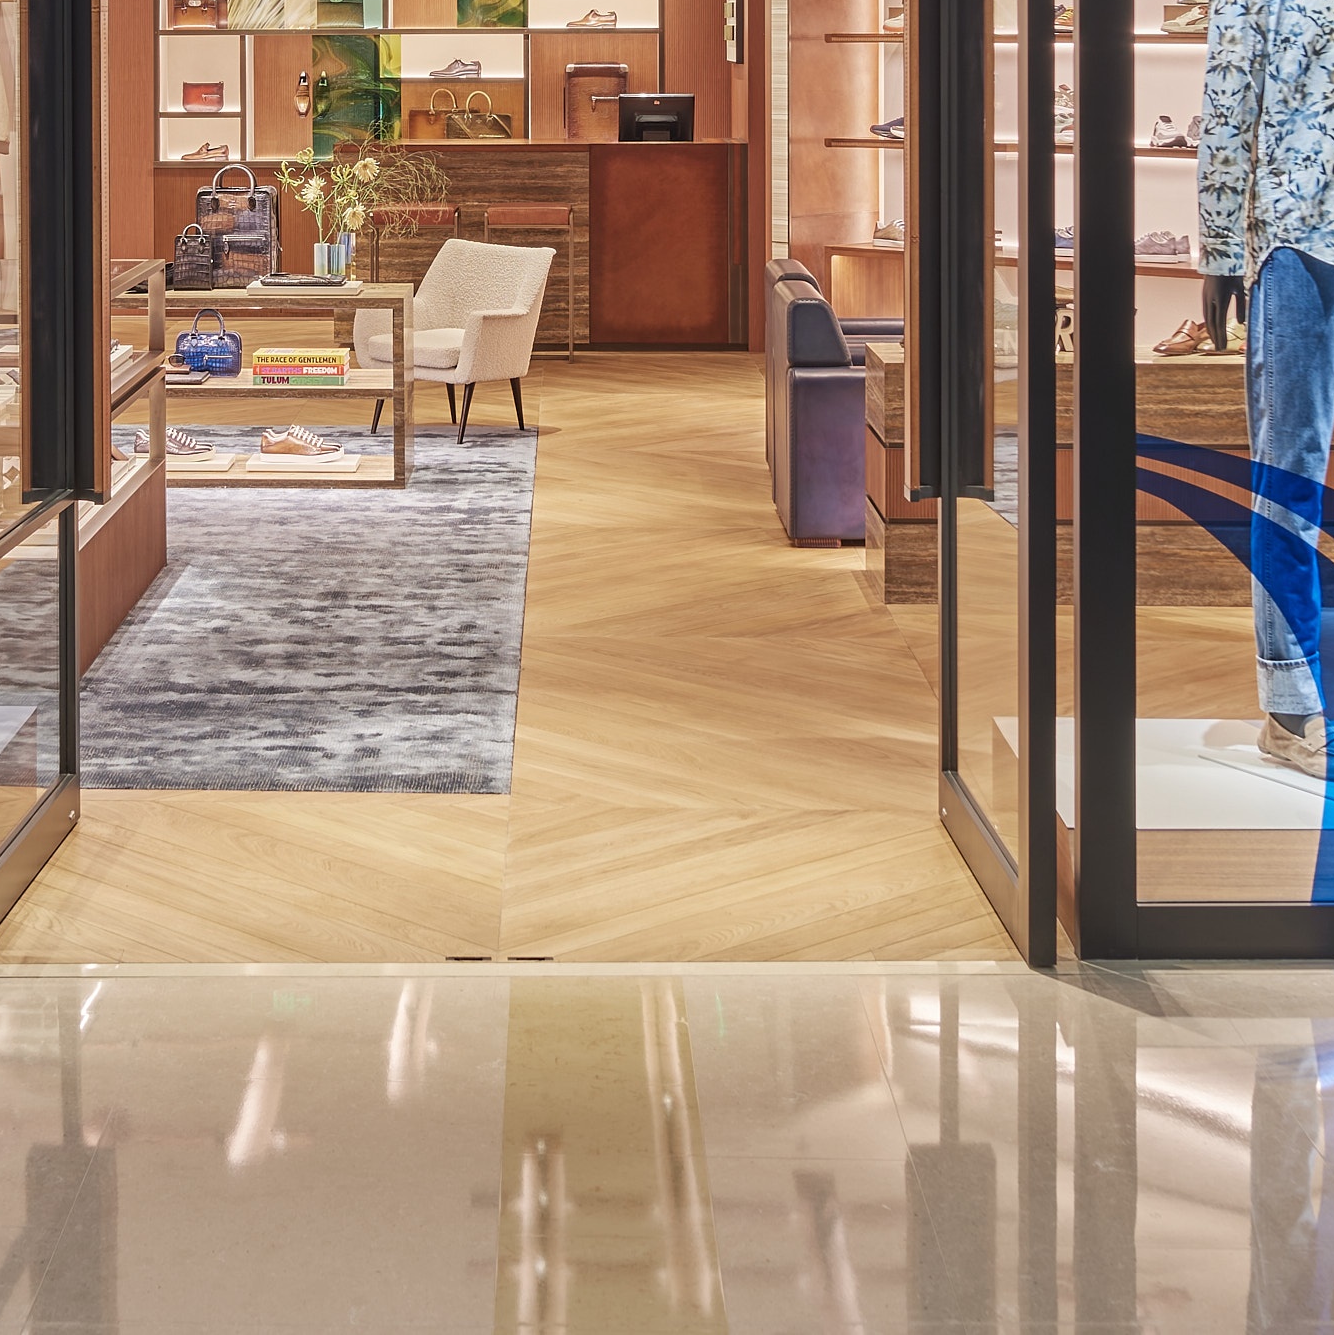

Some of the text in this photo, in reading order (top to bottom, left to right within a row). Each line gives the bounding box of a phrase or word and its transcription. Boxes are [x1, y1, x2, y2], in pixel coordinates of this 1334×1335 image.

[298, 356, 337, 364] GENTLEMEN
[302, 366, 338, 374] FREEDOM
[261, 376, 289, 384] TULUM
